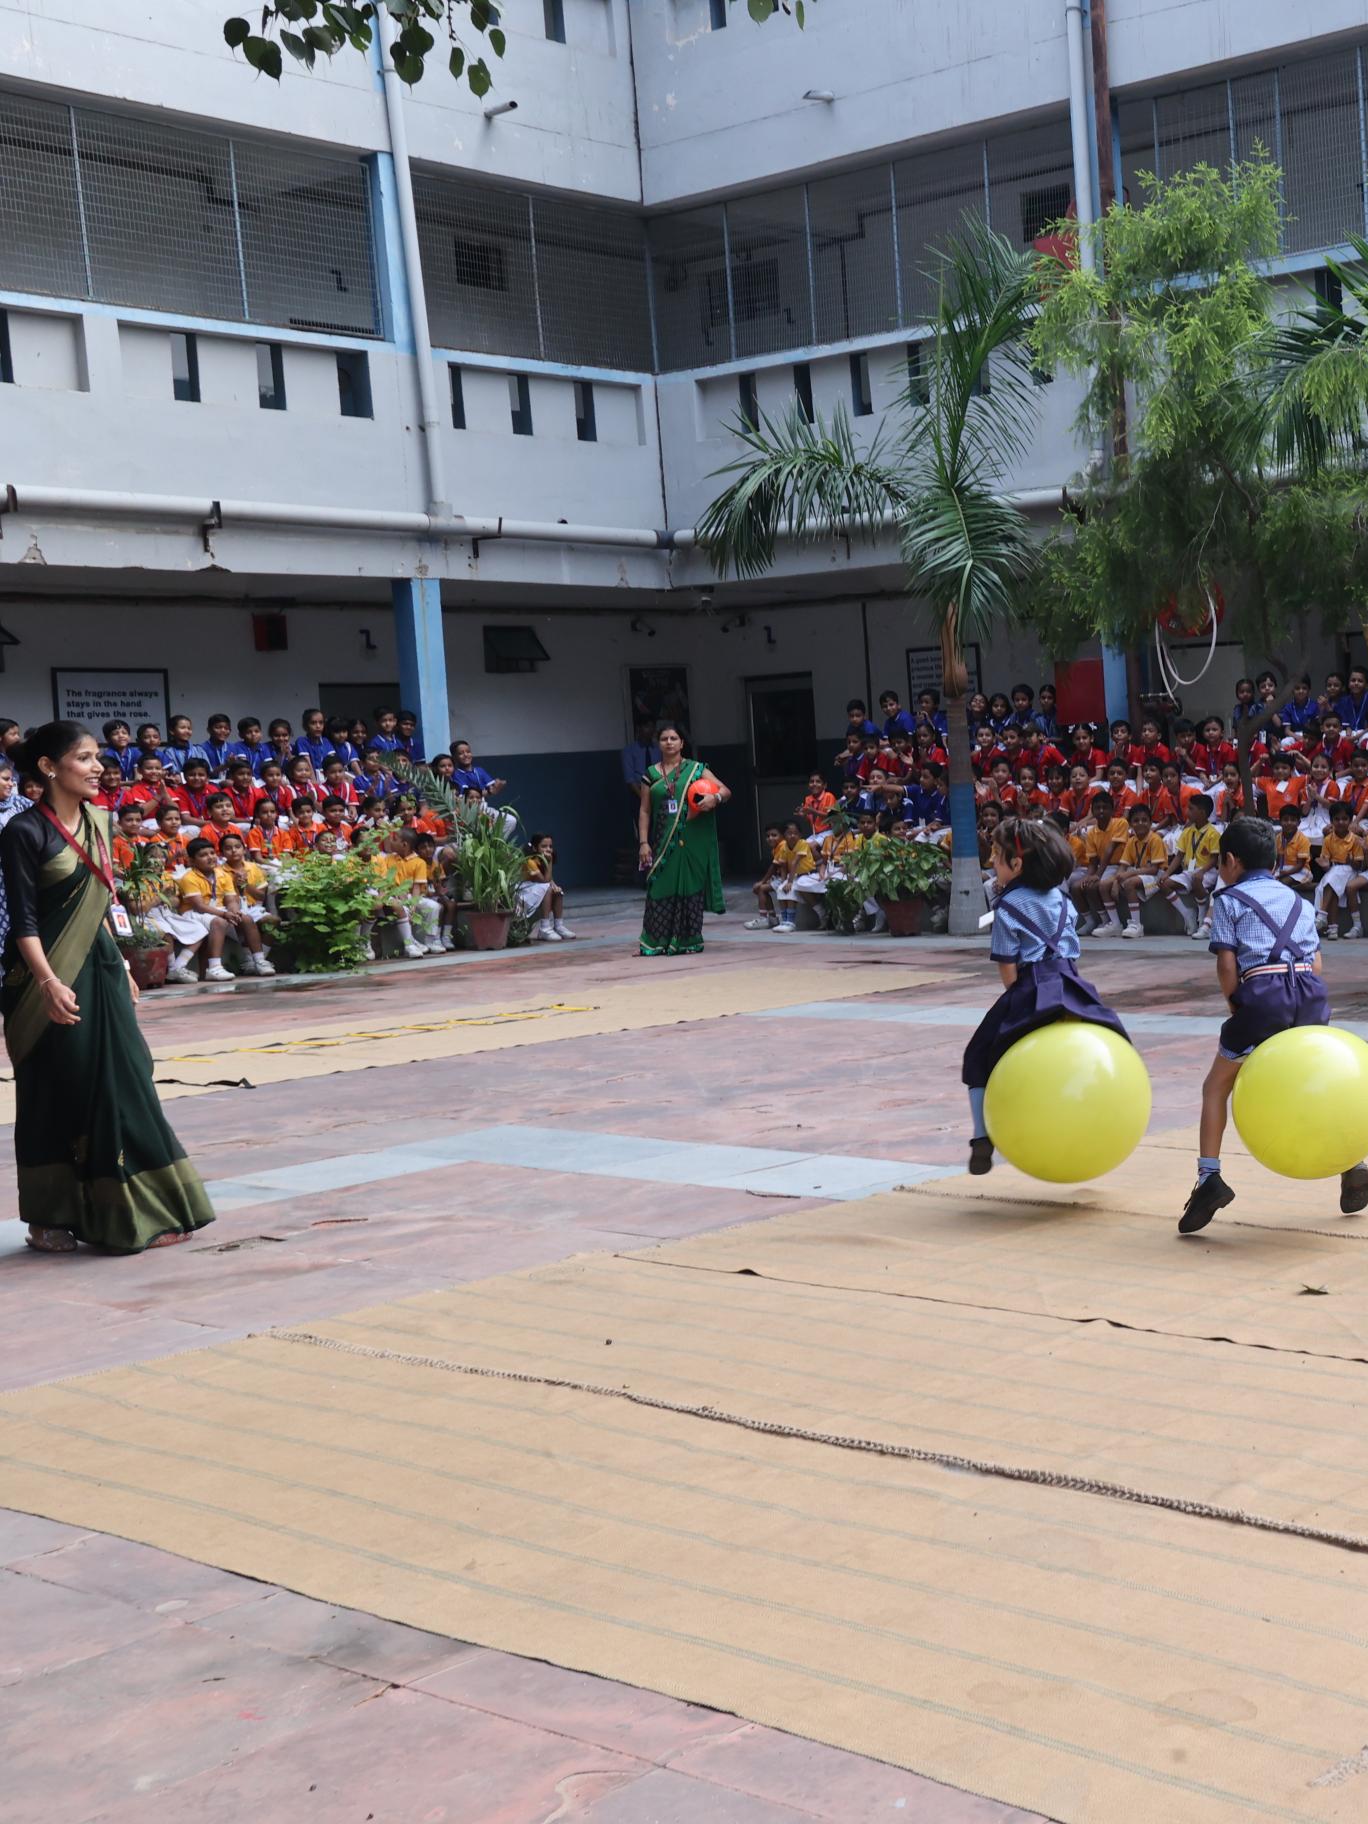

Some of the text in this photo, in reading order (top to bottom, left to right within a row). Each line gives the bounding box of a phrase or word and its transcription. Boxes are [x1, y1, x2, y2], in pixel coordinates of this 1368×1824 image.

[66, 689, 159, 698] The fragrance always
[66, 699, 142, 709] stays in the hand
[67, 710, 85, 718] that
[87, 710, 110, 720] gives
[113, 710, 126, 718] the
